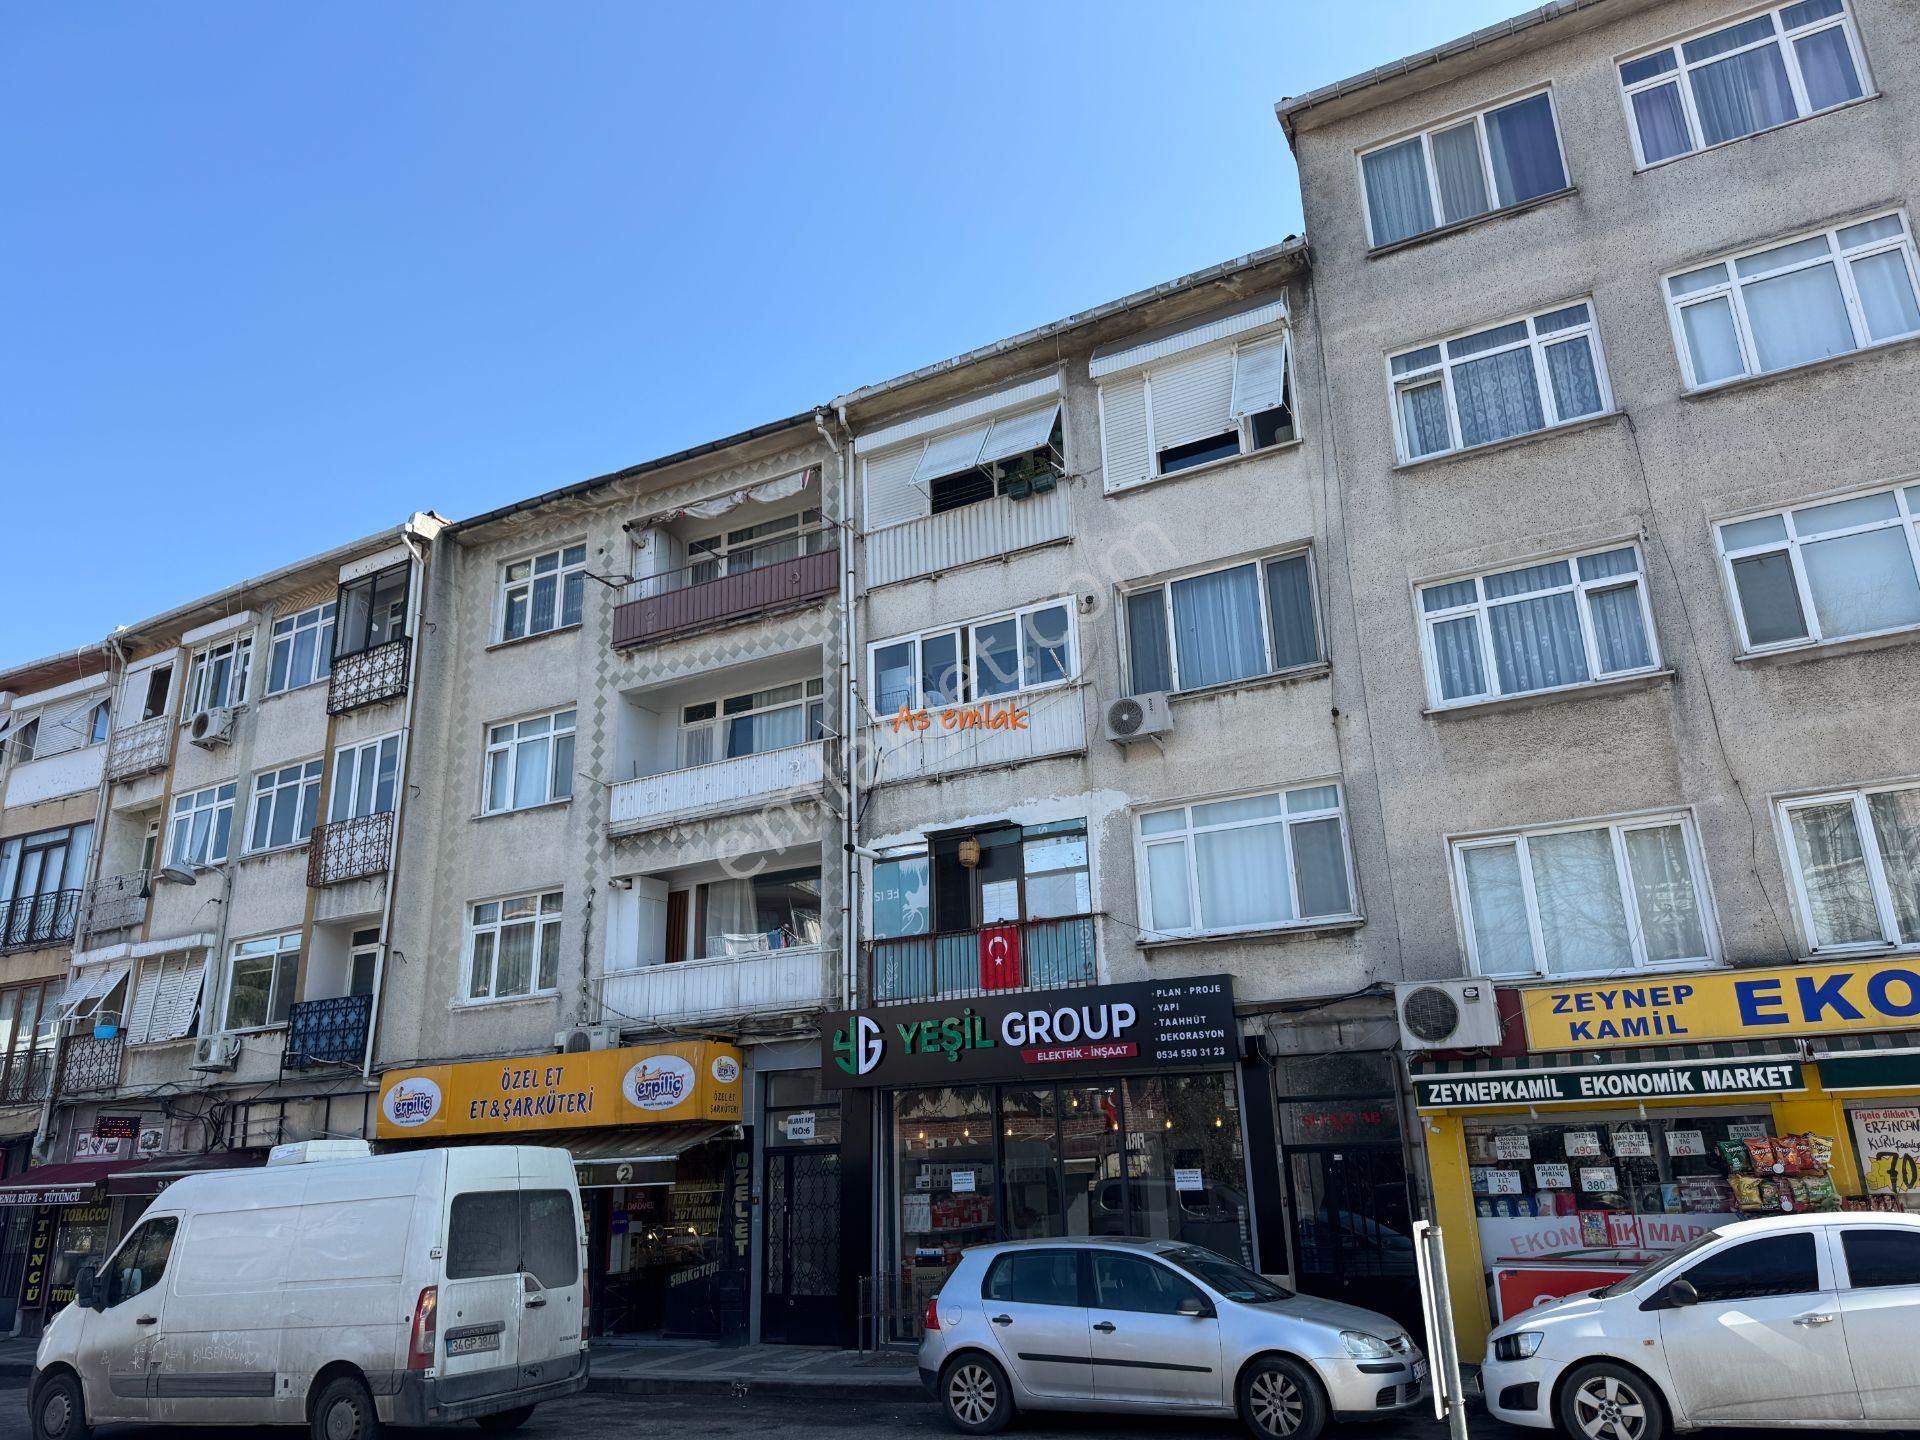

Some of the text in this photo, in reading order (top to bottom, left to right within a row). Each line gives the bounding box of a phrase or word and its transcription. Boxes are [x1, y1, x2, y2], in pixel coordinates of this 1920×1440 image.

[1156, 988, 1181, 998] PLAN
[1189, 984, 1222, 995] PROJE
[1734, 969, 1920, 1026] EKO
[1157, 1002, 1180, 1012] YAPI
[1551, 985, 1694, 1014] ZEYNEP
[1159, 1014, 1207, 1027] TAAHHÜT
[1569, 1011, 1689, 1041] KAMİL
[895, 1003, 1137, 1062] YEŞİL GROUP
[1160, 1029, 1225, 1042] DEKORASYON
[1037, 1048, 1082, 1061] ELEKTRİK
[1090, 1045, 1128, 1060] İNŞAAT
[1156, 1050, 1179, 1059] 0534
[1181, 1048, 1198, 1058] 550
[1200, 1047, 1211, 1057] 31
[501, 1066, 564, 1090] ÖZEL ET
[1428, 1065, 1793, 1103] ZEYNEPKAMİL EKONOMİK MARKET
[636, 1072, 683, 1100] erpiliç
[791, 1126, 811, 1135] NO:6
[1675, 1145, 1692, 1154] 160
[1867, 1134, 1896, 1151] KURU
[1502, 1150, 1519, 1159] 240
[1574, 1146, 1592, 1155] 490
[1876, 1152, 1917, 1193] 70
[1497, 1185, 1509, 1193] 30
[1545, 1178, 1558, 1187] 40
[1586, 1180, 1606, 1191] 380
[62, 1207, 110, 1223] TOBACCO
[1510, 1218, 1640, 1255] EKONİK
[453, 1340, 464, 1352] 34
[464, 1337, 477, 1350] GP
